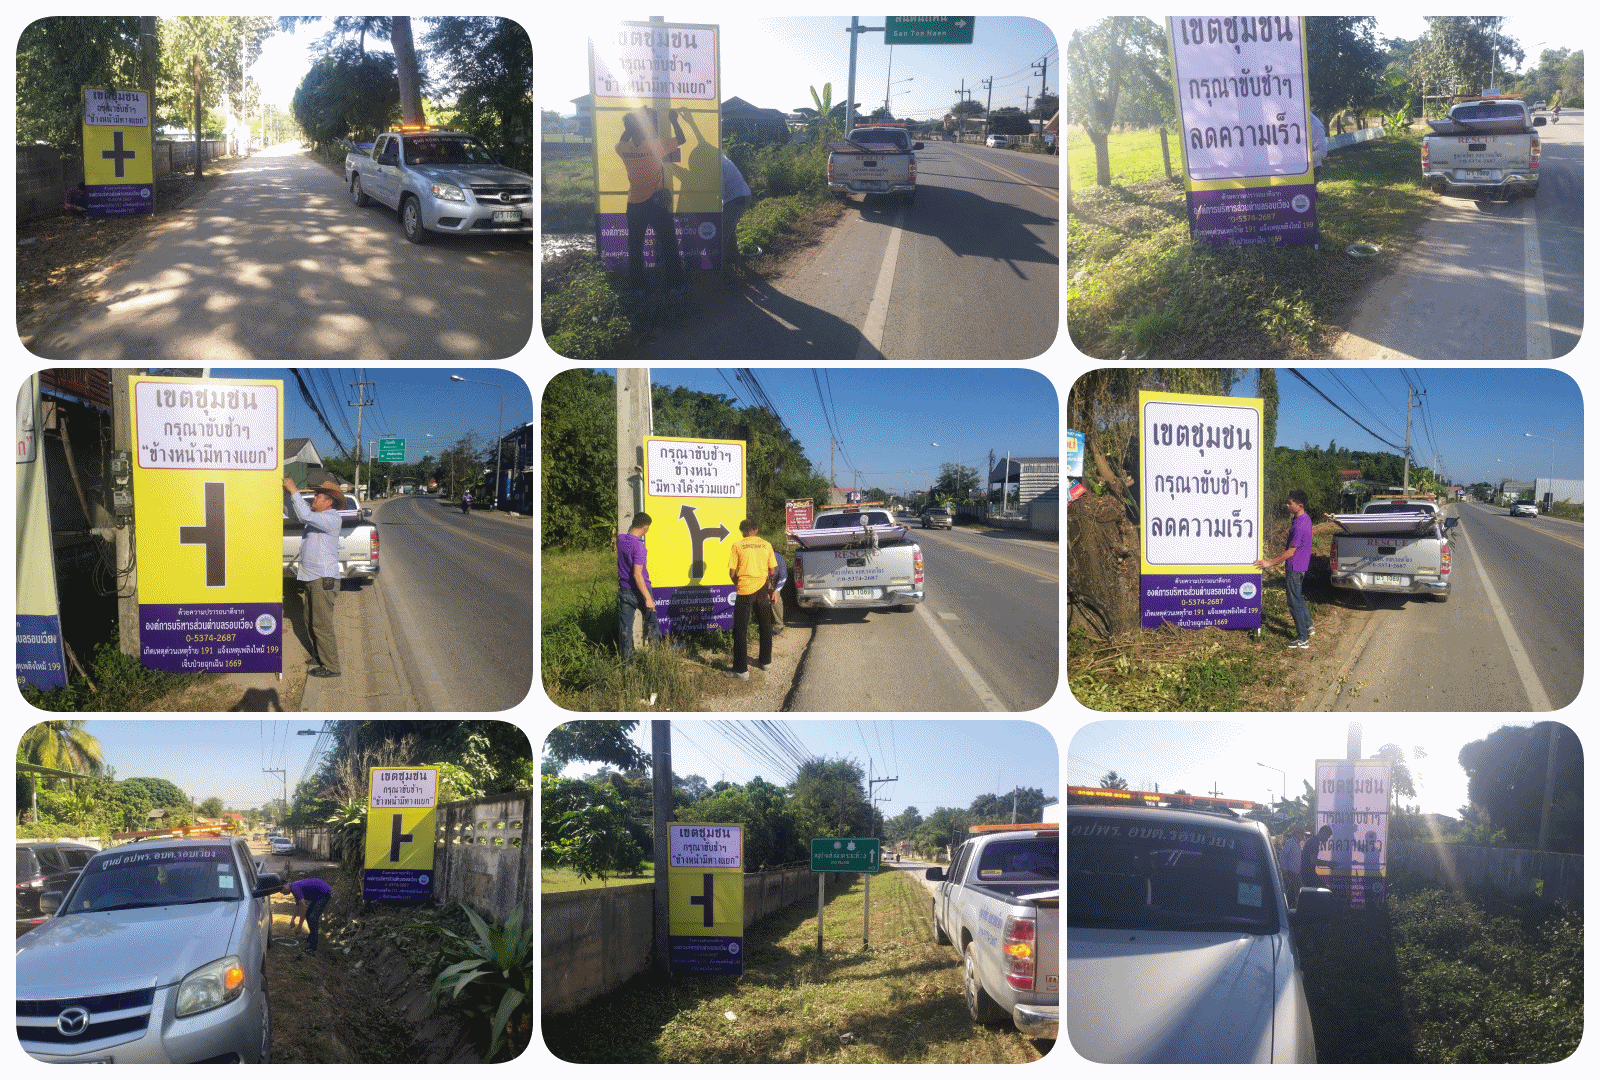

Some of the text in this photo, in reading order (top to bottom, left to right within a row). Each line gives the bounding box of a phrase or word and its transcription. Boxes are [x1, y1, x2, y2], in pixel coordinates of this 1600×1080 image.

[1188, 64, 1293, 107] กรุณาขับช้าๆ
[1190, 112, 1302, 150] ลดความเร็ว
[155, 388, 258, 416] เขตชุมชน
[164, 416, 250, 442] กรุณาขับช้าๆ
[1153, 422, 1252, 457] เขตชุมชน
[659, 445, 732, 463] กรุณาขับช้าๆ
[675, 461, 718, 477] ข้างหน้า
[1155, 468, 1248, 500] กรุณาขับช้าๆ
[1151, 508, 1253, 538] ลดความเร็ว
[1367, 539, 1409, 547] RESCUE
[1181, 598, 1224, 606] 0-5374-2687
[185, 633, 237, 643] 0-5374-2687
[201, 646, 214, 655] 191
[266, 645, 279, 654] 199
[225, 659, 242, 668] 1669
